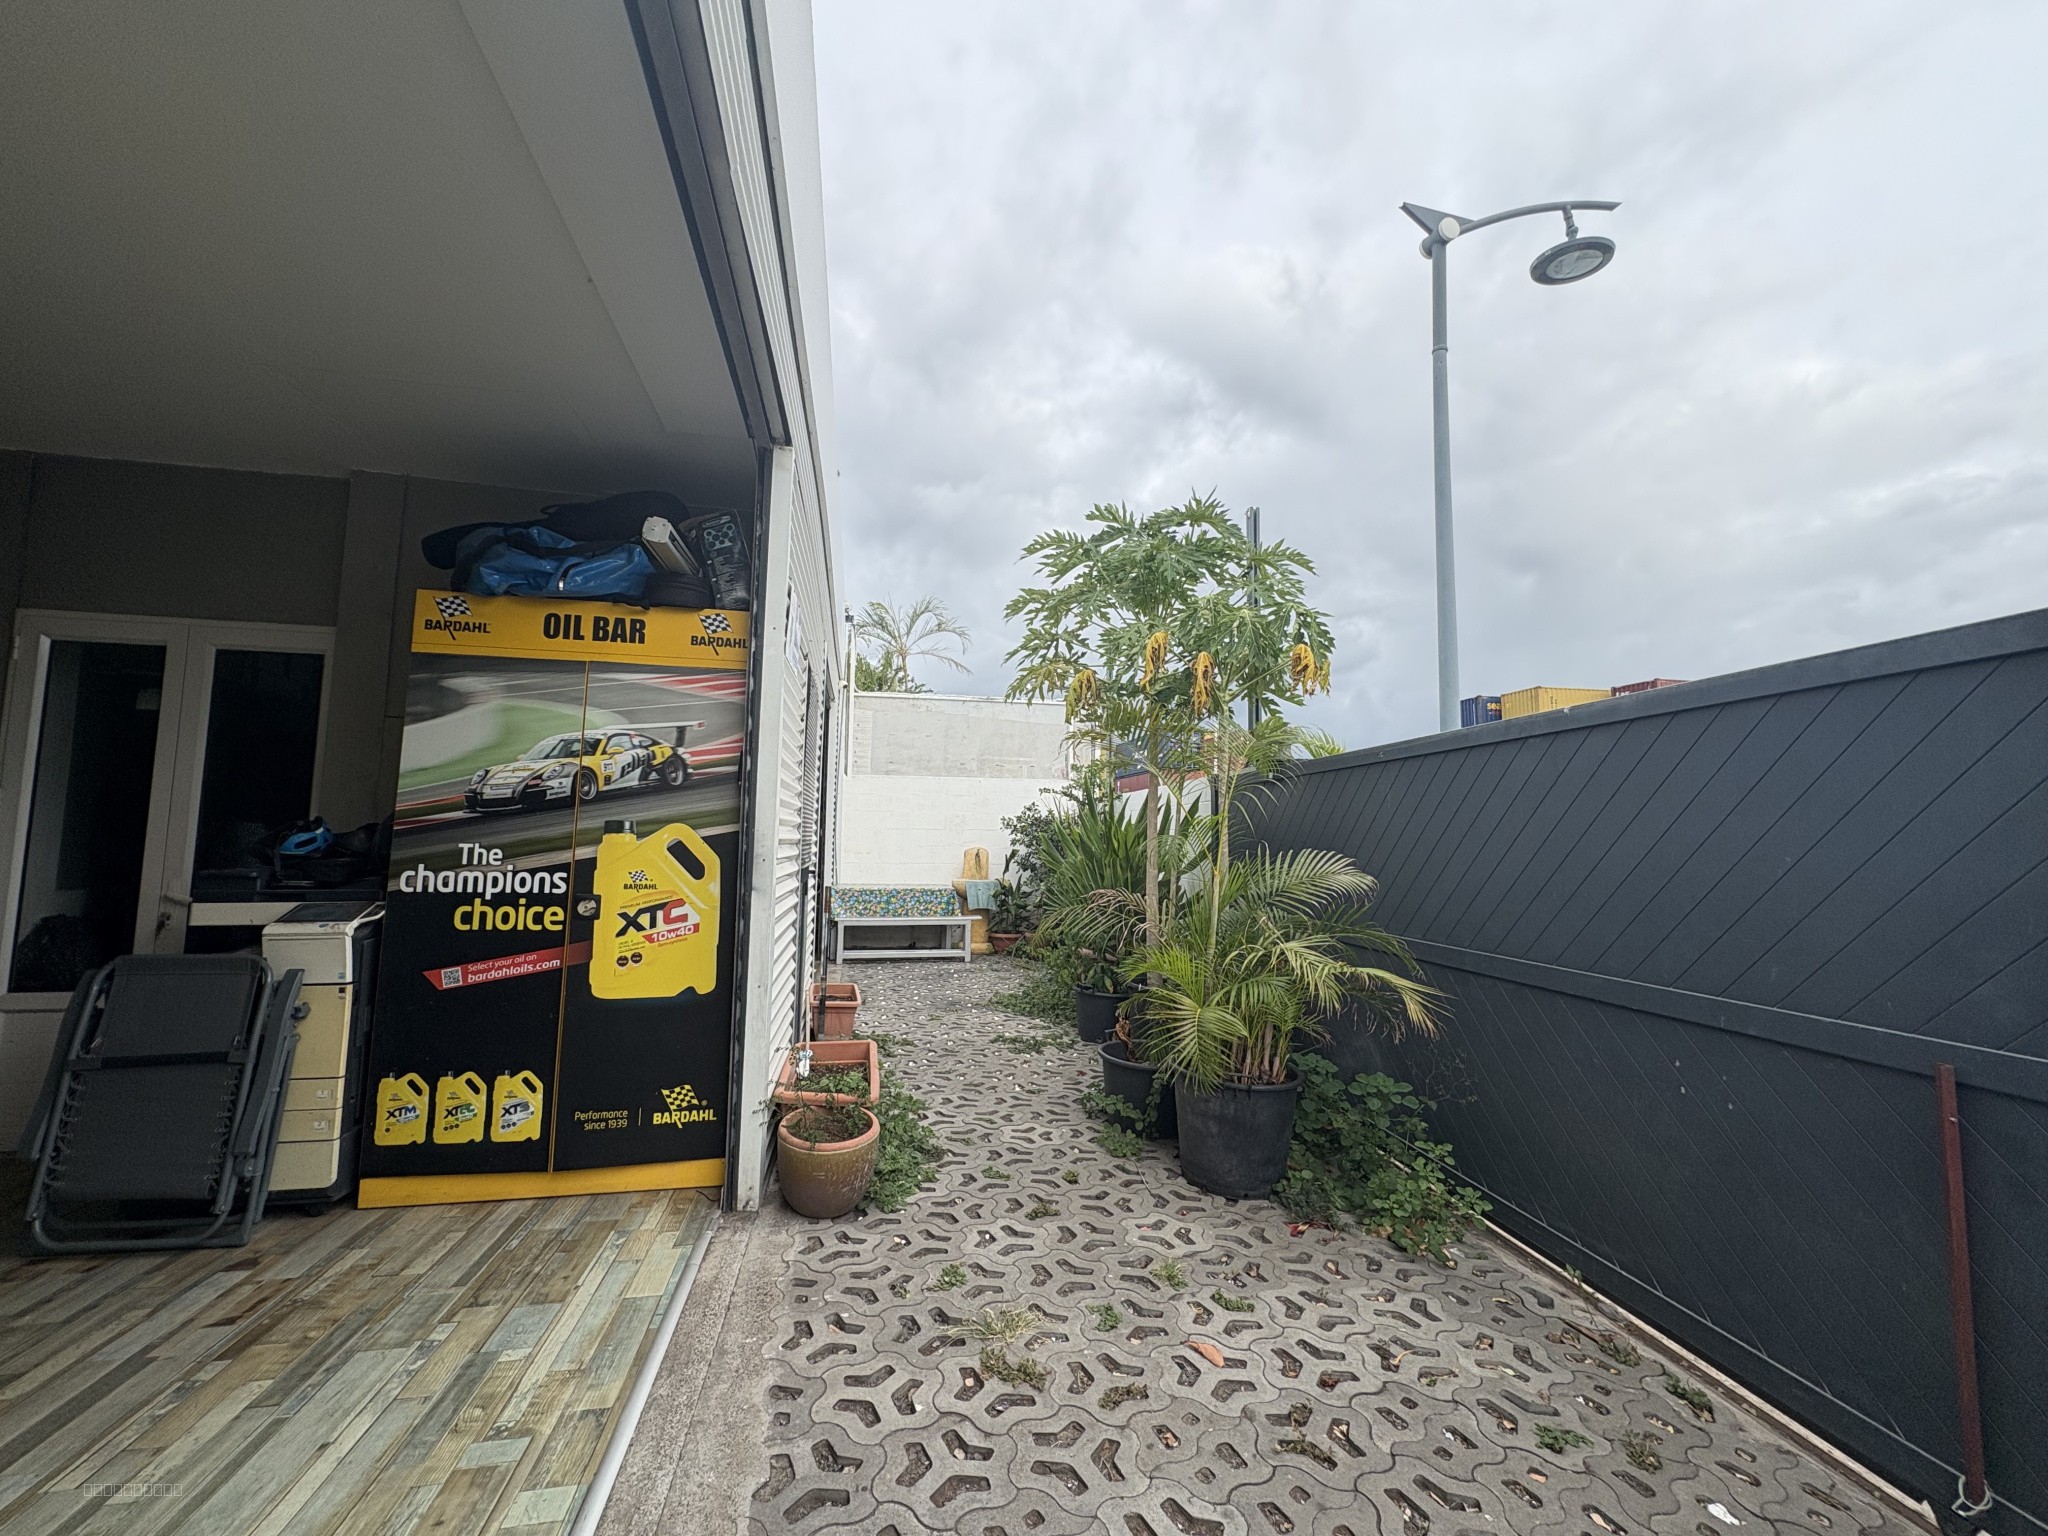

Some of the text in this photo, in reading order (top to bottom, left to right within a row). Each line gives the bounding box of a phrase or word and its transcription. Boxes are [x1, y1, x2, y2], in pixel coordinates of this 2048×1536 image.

[424, 619, 491, 634] BARDAHL
[543, 612, 646, 645] OIL BAR
[690, 635, 748, 649] BARDAHL
[458, 843, 503, 866] The
[399, 864, 568, 900] champions
[623, 883, 658, 891] BARDAHL
[453, 898, 565, 931] choice
[615, 898, 689, 938] XTC
[651, 925, 695, 942] 10w40
[467, 954, 537, 973] Select your oil on
[467, 958, 561, 983] bardahloils.com
[384, 1105, 417, 1121] XTM
[574, 1109, 629, 1121] Performance
[652, 1109, 718, 1125] BARDAHL
[584, 1119, 628, 1131] since 1939
